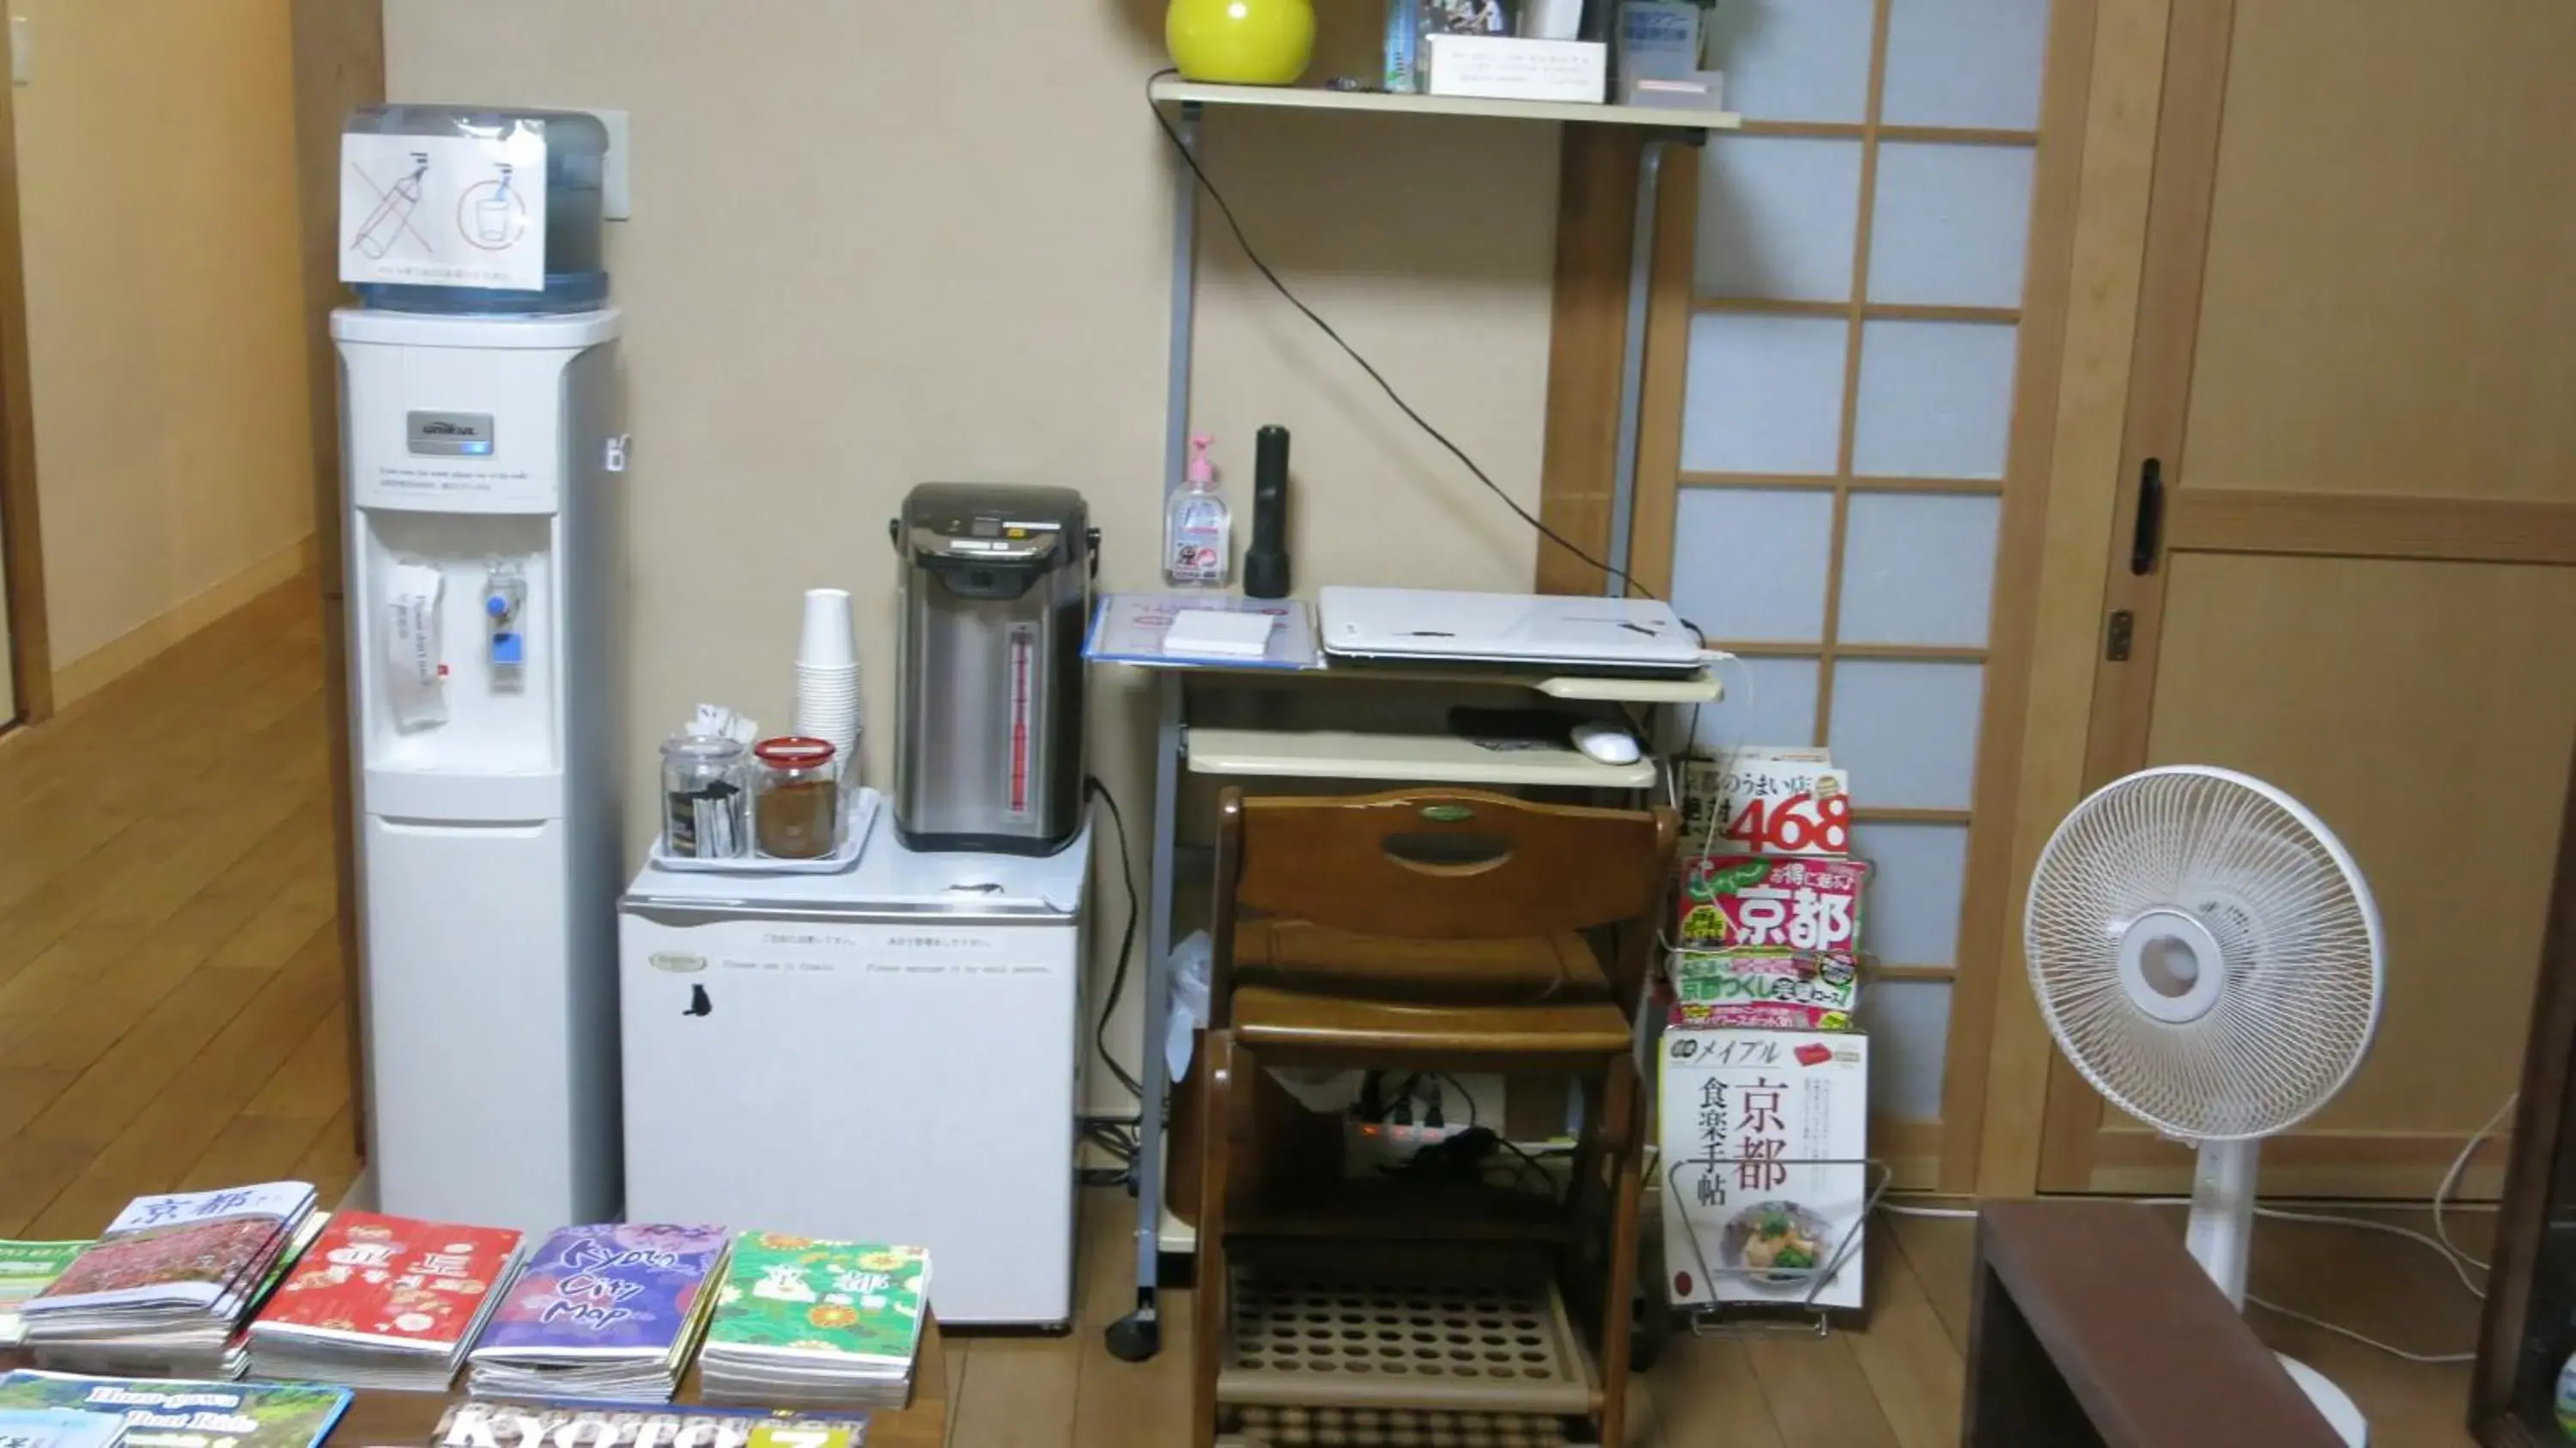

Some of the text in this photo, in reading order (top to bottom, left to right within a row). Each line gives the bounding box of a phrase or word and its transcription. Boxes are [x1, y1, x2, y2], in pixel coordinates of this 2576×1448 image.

[1722, 792, 1850, 853] 468
[1735, 884, 1853, 951] 京都
[1698, 1076, 1729, 1208] 食楽手帖
[1733, 1076, 1789, 1192] 京都
[130, 1189, 256, 1225] 京都
[562, 1238, 678, 1274] Kyoto
[558, 1272, 645, 1302] City
[541, 1299, 631, 1329] Map
[440, 1411, 744, 1448] KYOTO
